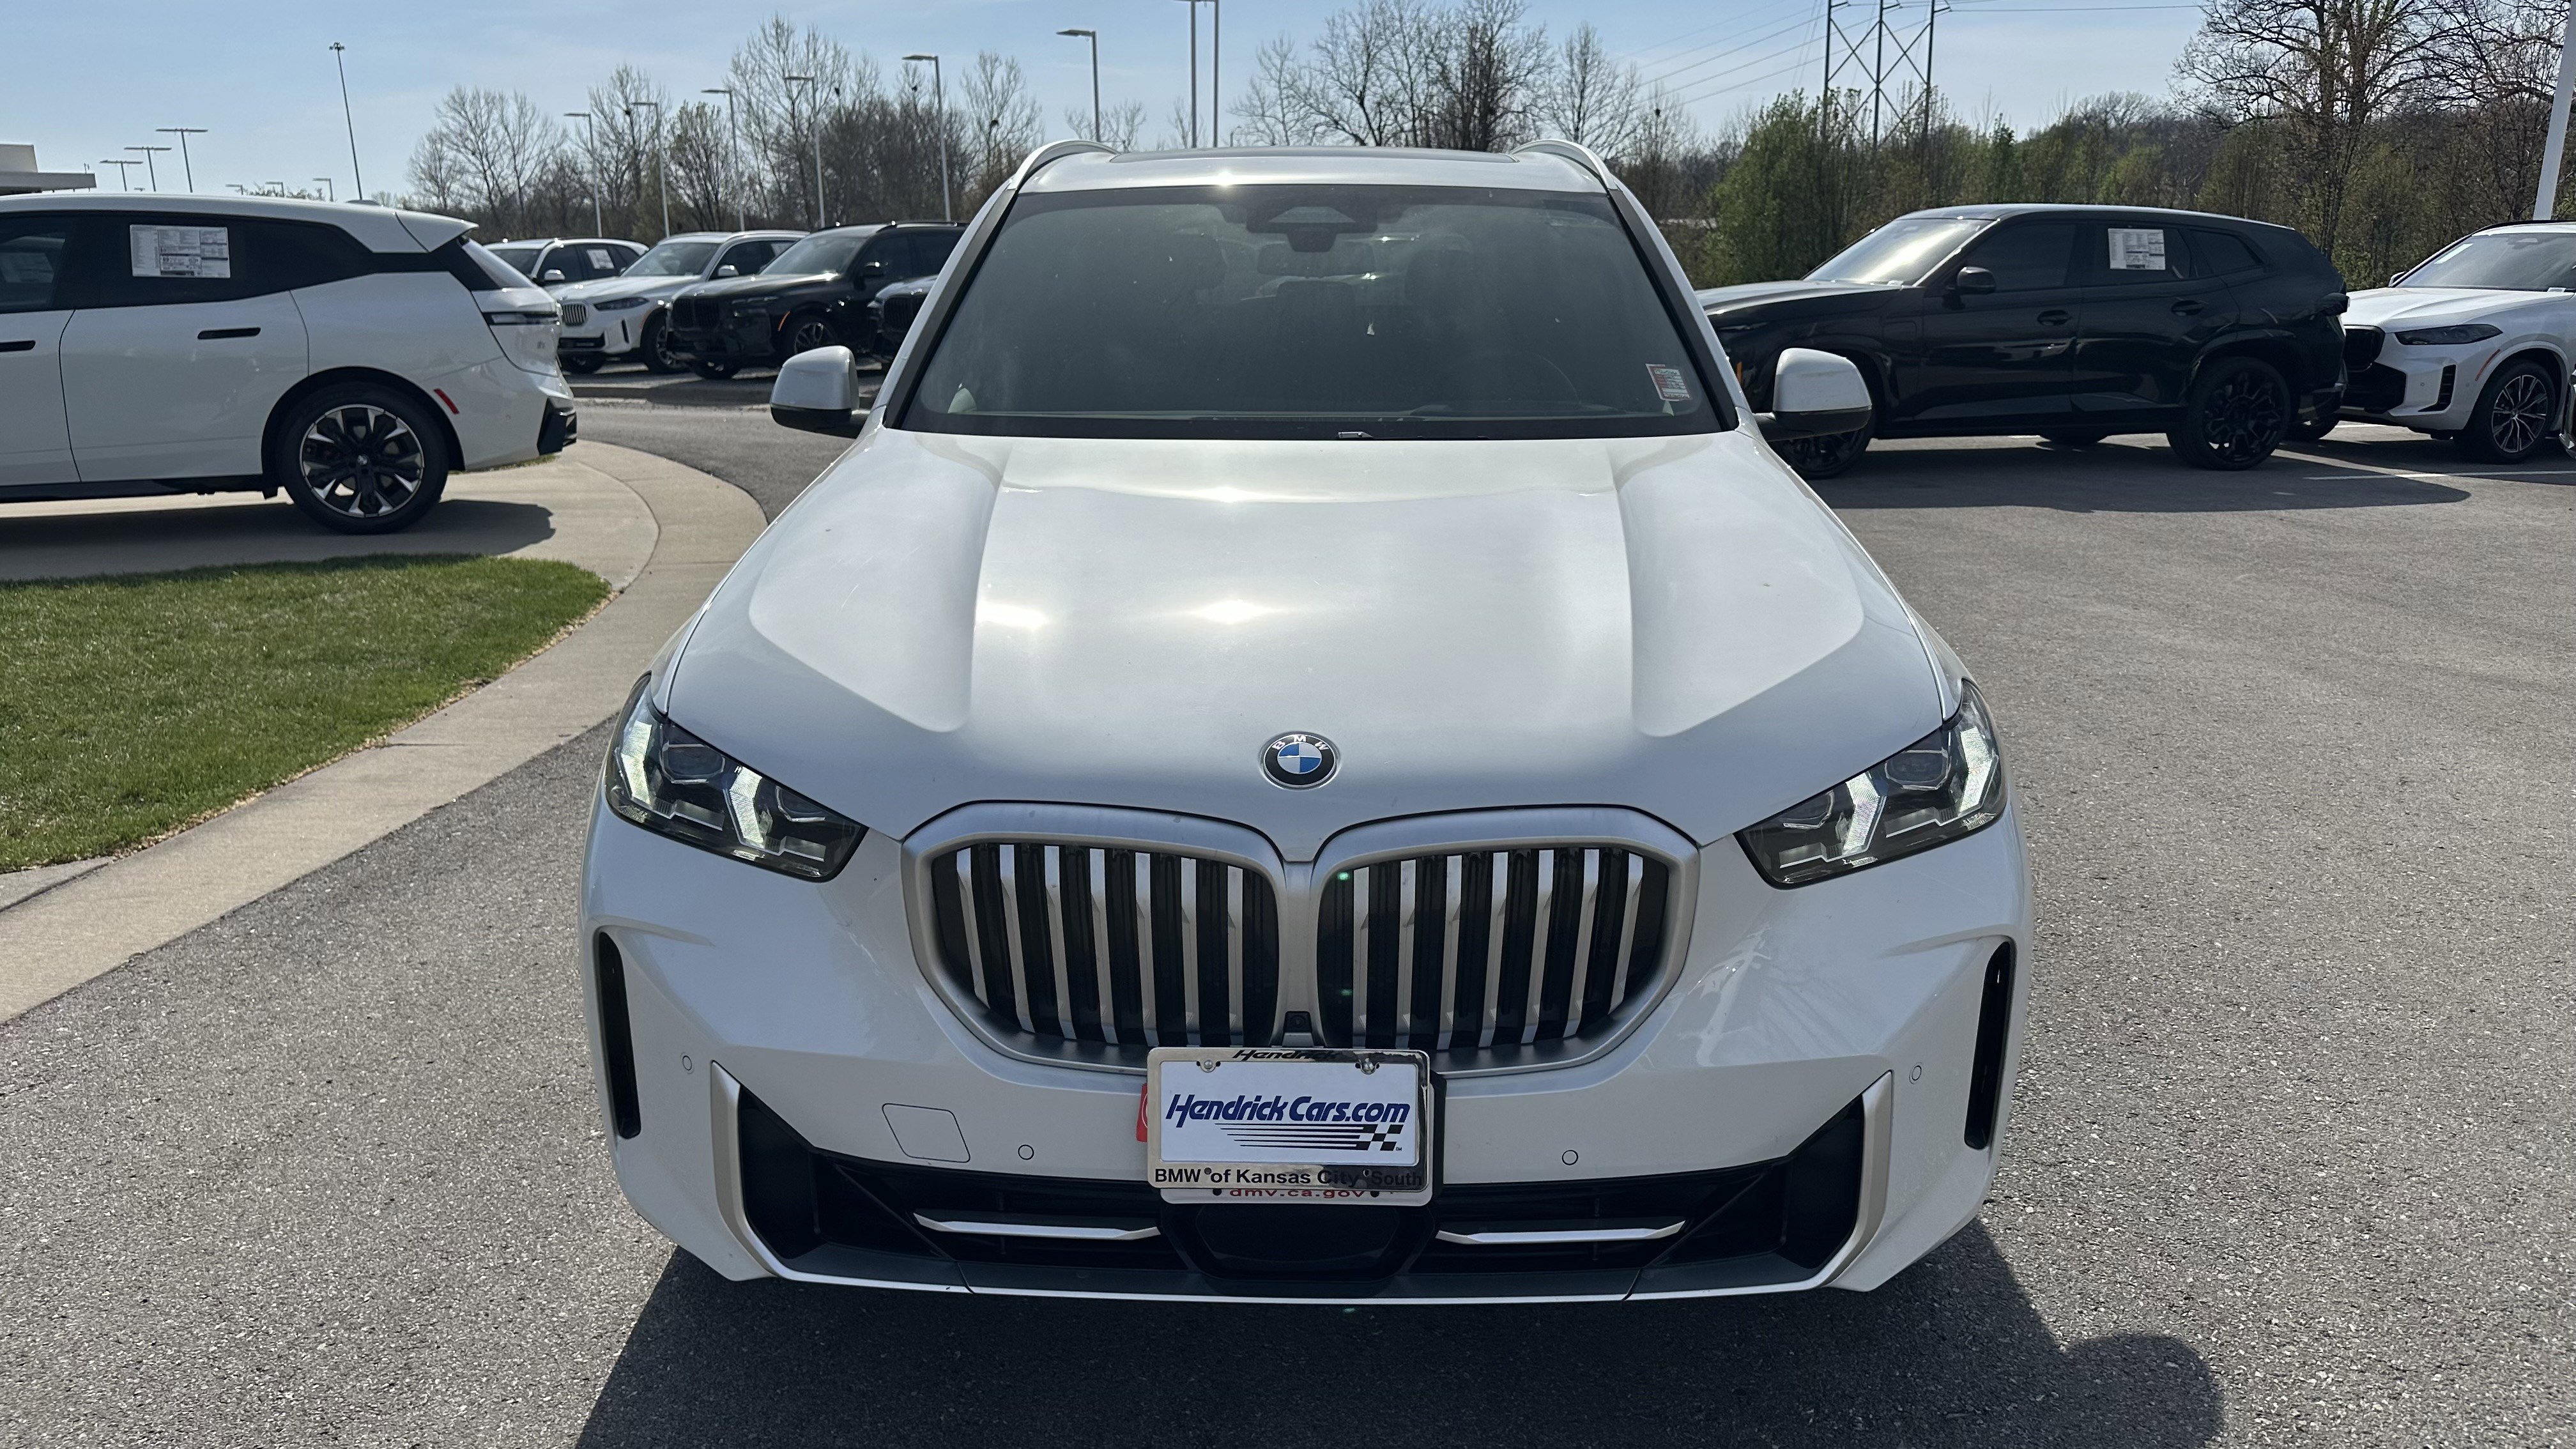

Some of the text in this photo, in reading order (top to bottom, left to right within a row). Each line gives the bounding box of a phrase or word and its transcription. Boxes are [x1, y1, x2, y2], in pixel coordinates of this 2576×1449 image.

[1271, 735, 1330, 751] BMW
[1155, 1169, 1423, 1188] BMW of Kansas City South
[1229, 1188, 1365, 1199] dmv.ca.gov
